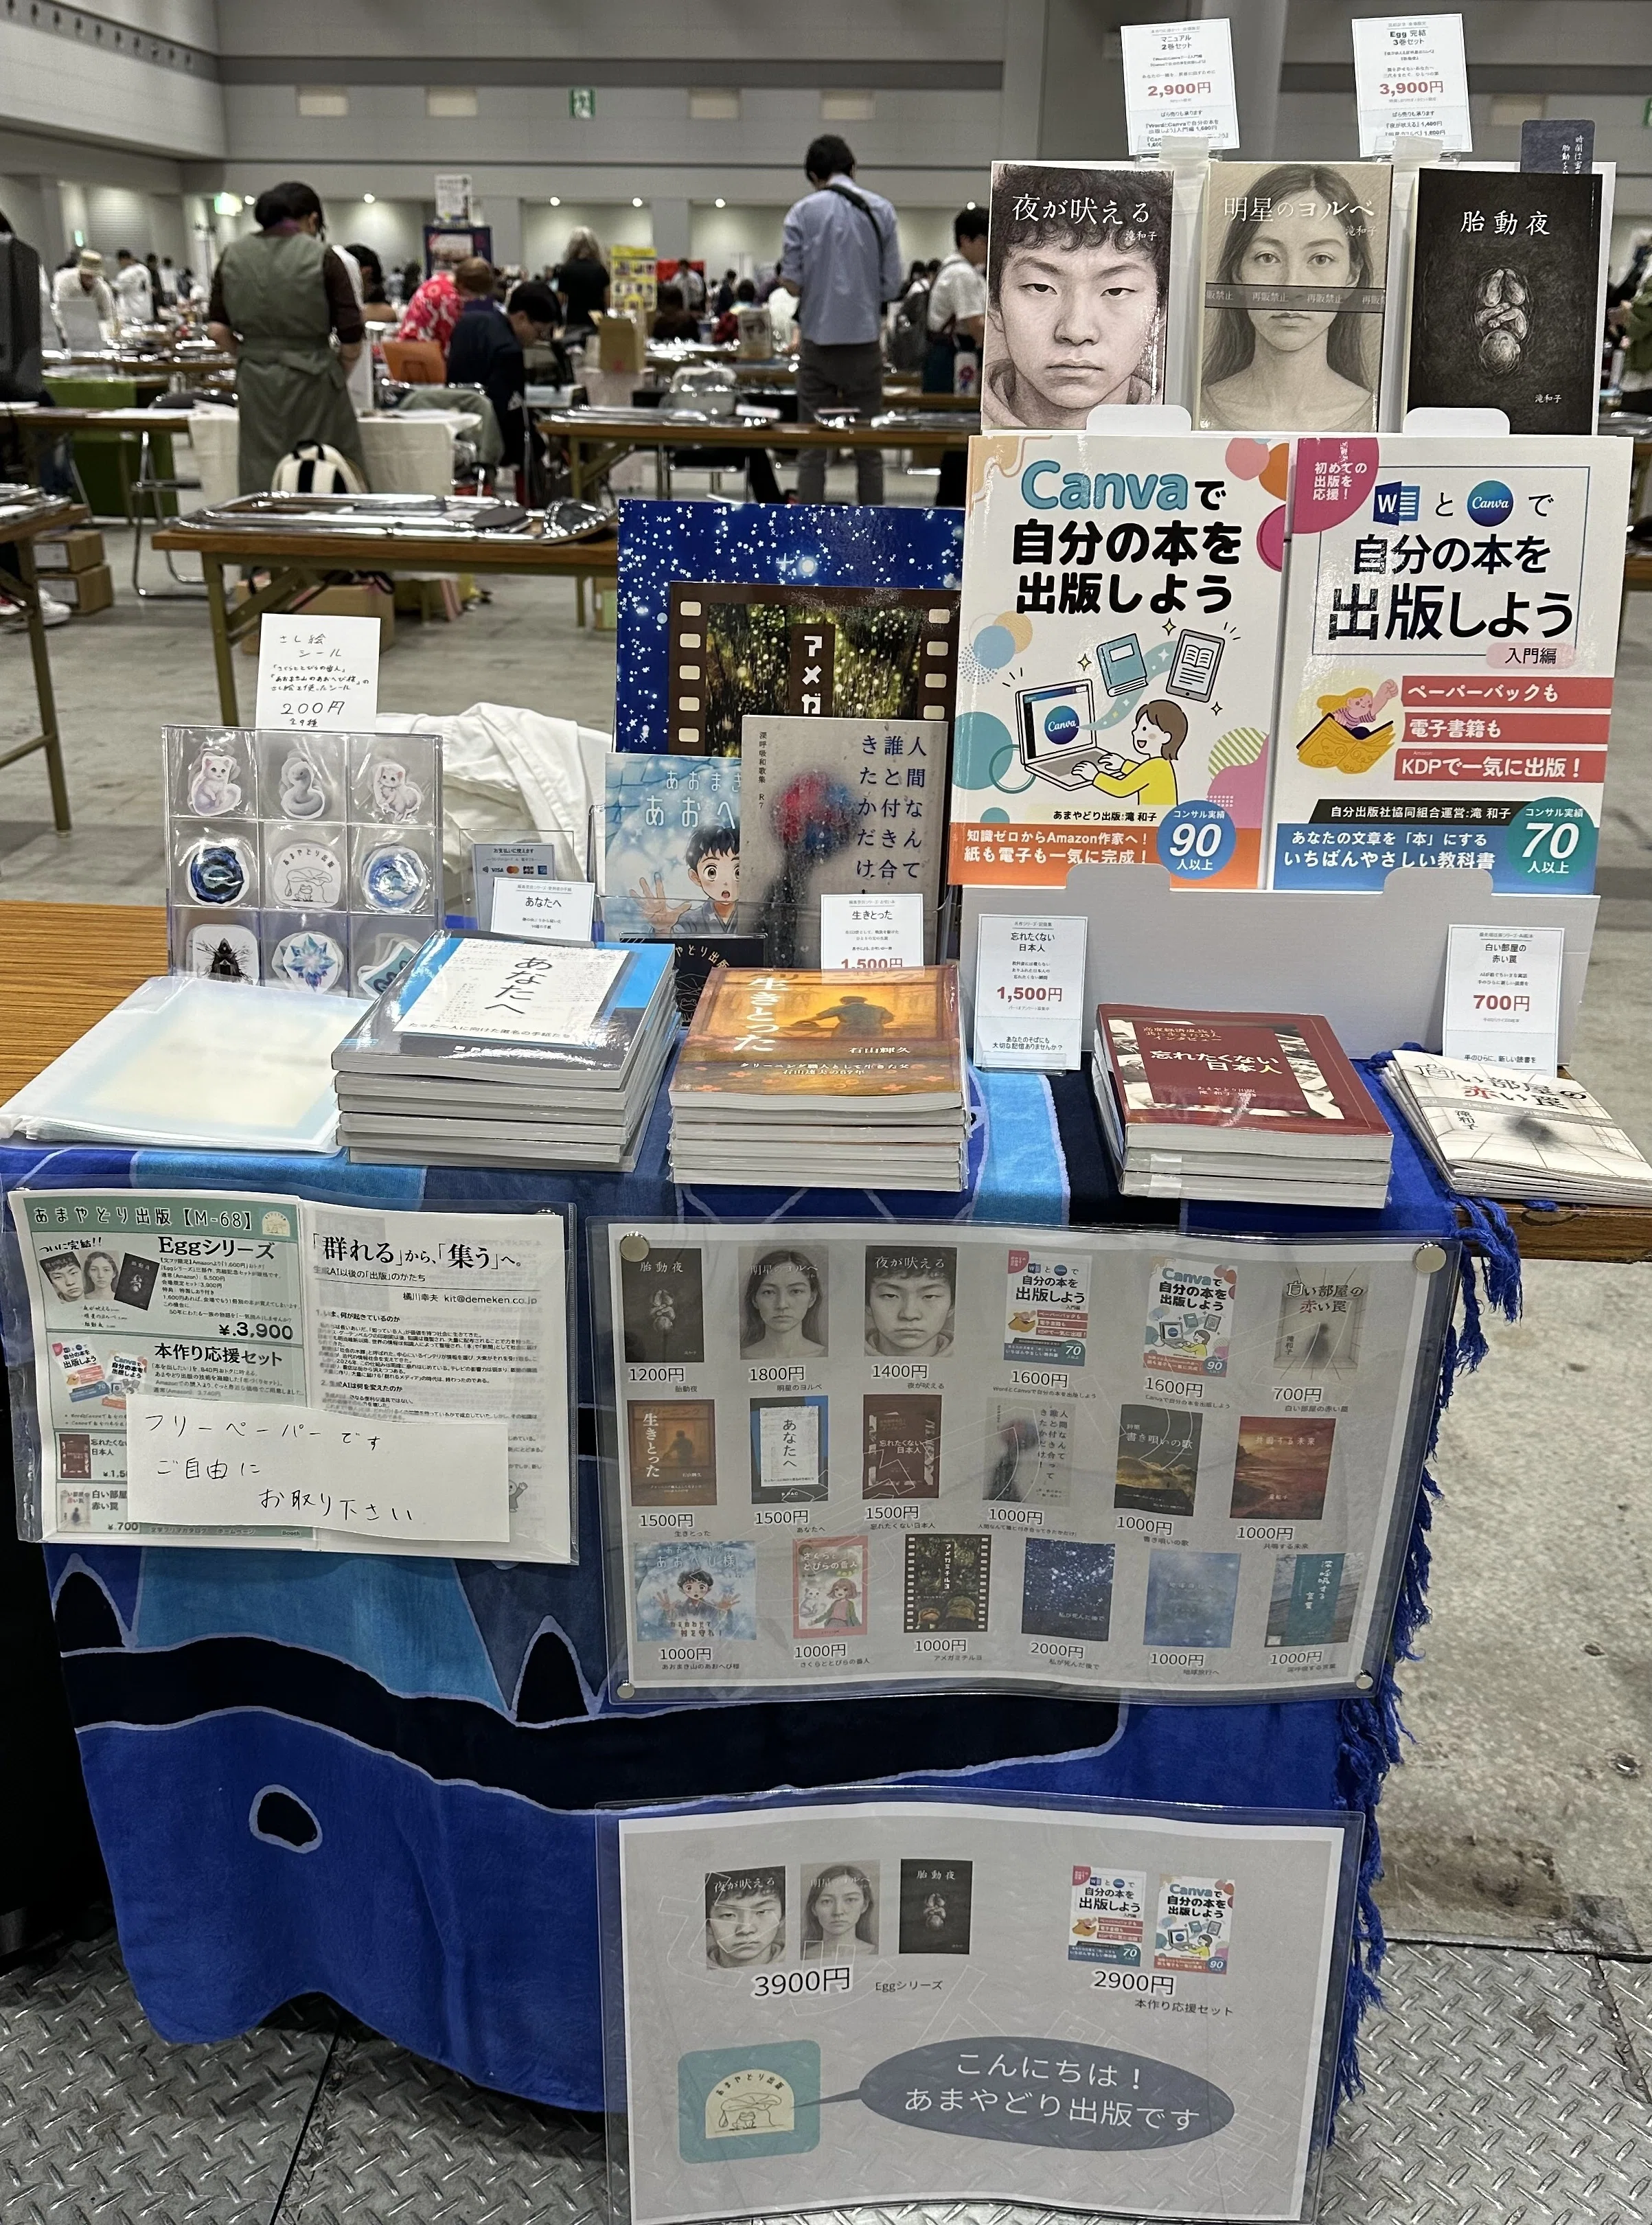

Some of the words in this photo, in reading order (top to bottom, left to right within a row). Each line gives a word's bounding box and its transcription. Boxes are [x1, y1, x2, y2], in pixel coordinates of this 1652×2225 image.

[1148, 82, 1211, 98] 2,900円
[1379, 81, 1443, 96] 3,900円
[1012, 194, 1150, 225] 夜が吠える
[1223, 195, 1375, 224] 明星のヨルベ
[1460, 210, 1551, 237] 胎動夜
[1314, 462, 1367, 474] 初めての
[1020, 459, 1226, 512] Canvaで
[1314, 475, 1352, 488] 出版を
[1313, 488, 1349, 501] 応援!
[1377, 492, 1395, 514] W
[1435, 492, 1454, 517] と
[1471, 495, 1509, 510] Canva
[1528, 493, 1554, 518] で
[1013, 519, 1242, 566] 自分の本を
[1353, 534, 1551, 575] 自分の本を
[1016, 572, 1234, 615] 出版しよう
[1328, 584, 1574, 641] 出版しよう
[280, 634, 325, 644] さし絵
[299, 648, 341, 657] シール
[1505, 648, 1557, 665] 入門編
[802, 635, 823, 715] アメガ
[1408, 685, 1558, 703] ペーパーバックも
[281, 700, 345, 715] 200円
[1048, 720, 1077, 731] Canva
[1410, 720, 1501, 738] 電子書籍も
[1401, 757, 1580, 778] KDPで一気に出版!
[645, 794, 736, 829] あおへ
[857, 735, 877, 879] きたかだけ
[878, 735, 904, 880] 誰と付き合
[902, 735, 927, 879] 人間なんて
[1173, 810, 1225, 820] コンサル実績
[1525, 808, 1583, 819] コンサル実績
[967, 829, 1148, 845] 知識ゼロからAmazon作家へ!
[1169, 824, 1222, 857] 90
[1291, 832, 1487, 847] あなたの文章を「本」にする
[1521, 823, 1579, 859] 70
[963, 846, 1147, 865] 紙も電子も一気に完成!
[1284, 850, 1495, 870] いちばんやさしい教科書
[1177, 858, 1214, 871] 人以上
[1528, 861, 1570, 874] 人以上
[525, 897, 562, 908] あなたへ
[852, 910, 893, 920] 生きとった
[1011, 933, 1055, 942] 忘れたくない
[1485, 943, 1526, 952] 白い部屋の
[1492, 955, 1517, 963] 赤い罠
[485, 957, 552, 1014] あなたへ
[997, 987, 1062, 1003] 1,500円
[1473, 995, 1530, 1012] 700円
[733, 978, 789, 1052] 生きとった
[1149, 1051, 1279, 1064] 忘れたくない
[1206, 1062, 1283, 1074] 日本人
[1414, 1064, 1587, 1099] 白い部屋の
[1461, 1086, 1569, 1109] 赤い罠
[34, 1207, 253, 1231] あまやどり出版【M-68】
[39, 1237, 102, 1253] ついに完結!!
[157, 1237, 275, 1259] Eggシリーズ
[313, 1233, 521, 1270] 「群れる」から、「集う」へ。
[640, 1261, 683, 1273] 胎動夜
[875, 1256, 945, 1269] 夜が吠える
[1022, 1275, 1078, 1289] 自分の本を
[1162, 1267, 1223, 1288] Canvaで
[1016, 1287, 1086, 1304] 出版しよう
[1159, 1281, 1228, 1301] 自分の本を
[1287, 1281, 1364, 1297] 白い部屋の
[1160, 1294, 1224, 1312] 出版しよう
[1299, 1300, 1347, 1314] 赤い罠
[154, 1343, 283, 1367] 本作り応援セット
[1066, 1345, 1082, 1356] 70
[750, 1366, 805, 1381] 1800円
[872, 1365, 928, 1379] 1400円
[1206, 1360, 1224, 1371] 90
[629, 1367, 684, 1382] 1200円
[1011, 1371, 1068, 1388] 1600円
[675, 1385, 698, 1393] 胎動夜
[1145, 1378, 1203, 1398] 1600円
[1274, 1387, 1322, 1403] 700円
[145, 1414, 381, 1452] フリーペーパーです
[1057, 1409, 1068, 1459] 人間なんて
[643, 1413, 660, 1478] 生きとった
[783, 1419, 797, 1468] あなたへ
[897, 1446, 921, 1454] 日本人
[91, 1448, 114, 1457] 日本人
[156, 1459, 262, 1480] ご自由に
[92, 1502, 118, 1511] 赤い罠
[258, 1489, 413, 1522] お取り下さい
[866, 1506, 919, 1520] 1500円
[640, 1514, 693, 1527] 1500円
[755, 1510, 809, 1525] 1500円
[989, 1508, 1043, 1525] 1000円
[1117, 1517, 1173, 1536] 1000円
[1237, 1526, 1294, 1541] 1000円
[794, 1643, 847, 1659] 1000円
[915, 1639, 967, 1652] 1000円
[1031, 1642, 1084, 1659] 2000円
[660, 1648, 712, 1661] 1000円
[1150, 1653, 1204, 1667] 1000円
[1271, 1651, 1322, 1665] 1000円
[917, 1869, 956, 1881] 胎動夜
[755, 1967, 851, 1997] 3900円
[875, 1980, 943, 1993] Eggシリーズ
[1094, 1970, 1173, 1996] 2900円
[1134, 1999, 1233, 2016] 本作り応援セット
[955, 2052, 1143, 2090] こんにちは!
[904, 2087, 1201, 2132] あまやどり出版です
